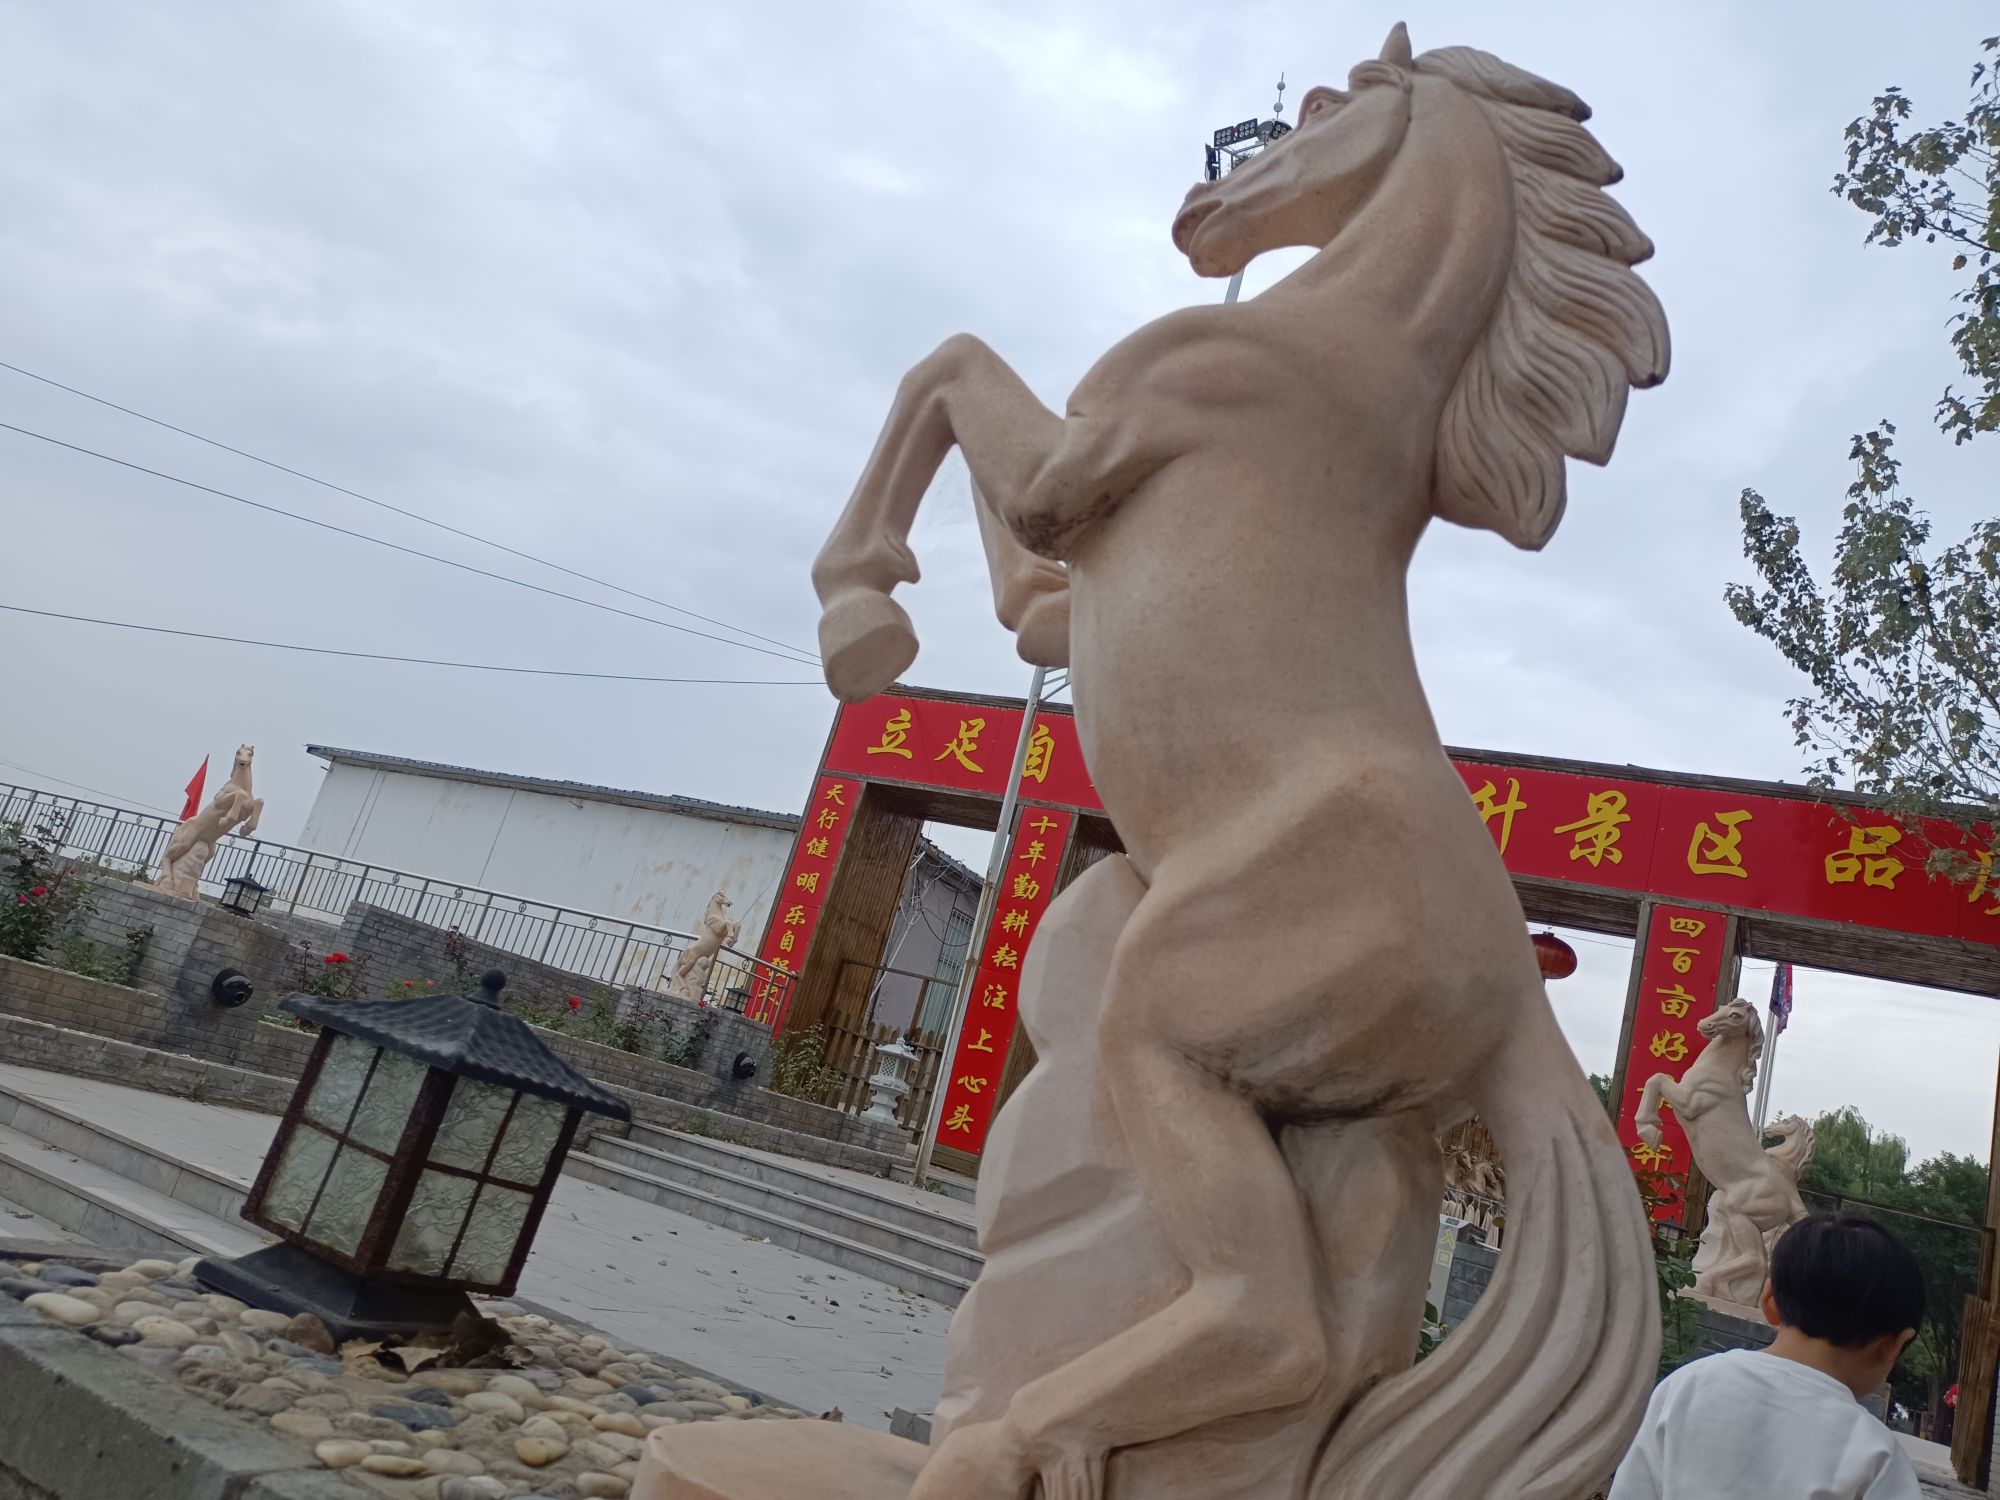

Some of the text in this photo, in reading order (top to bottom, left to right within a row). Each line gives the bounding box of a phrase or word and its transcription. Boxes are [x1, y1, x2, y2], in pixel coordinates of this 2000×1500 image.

[867, 708, 1094, 787] 立足自
[945, 815, 1058, 1134] 十年勤耕耘注上心头
[1436, 1229, 1456, 1267] 入口
